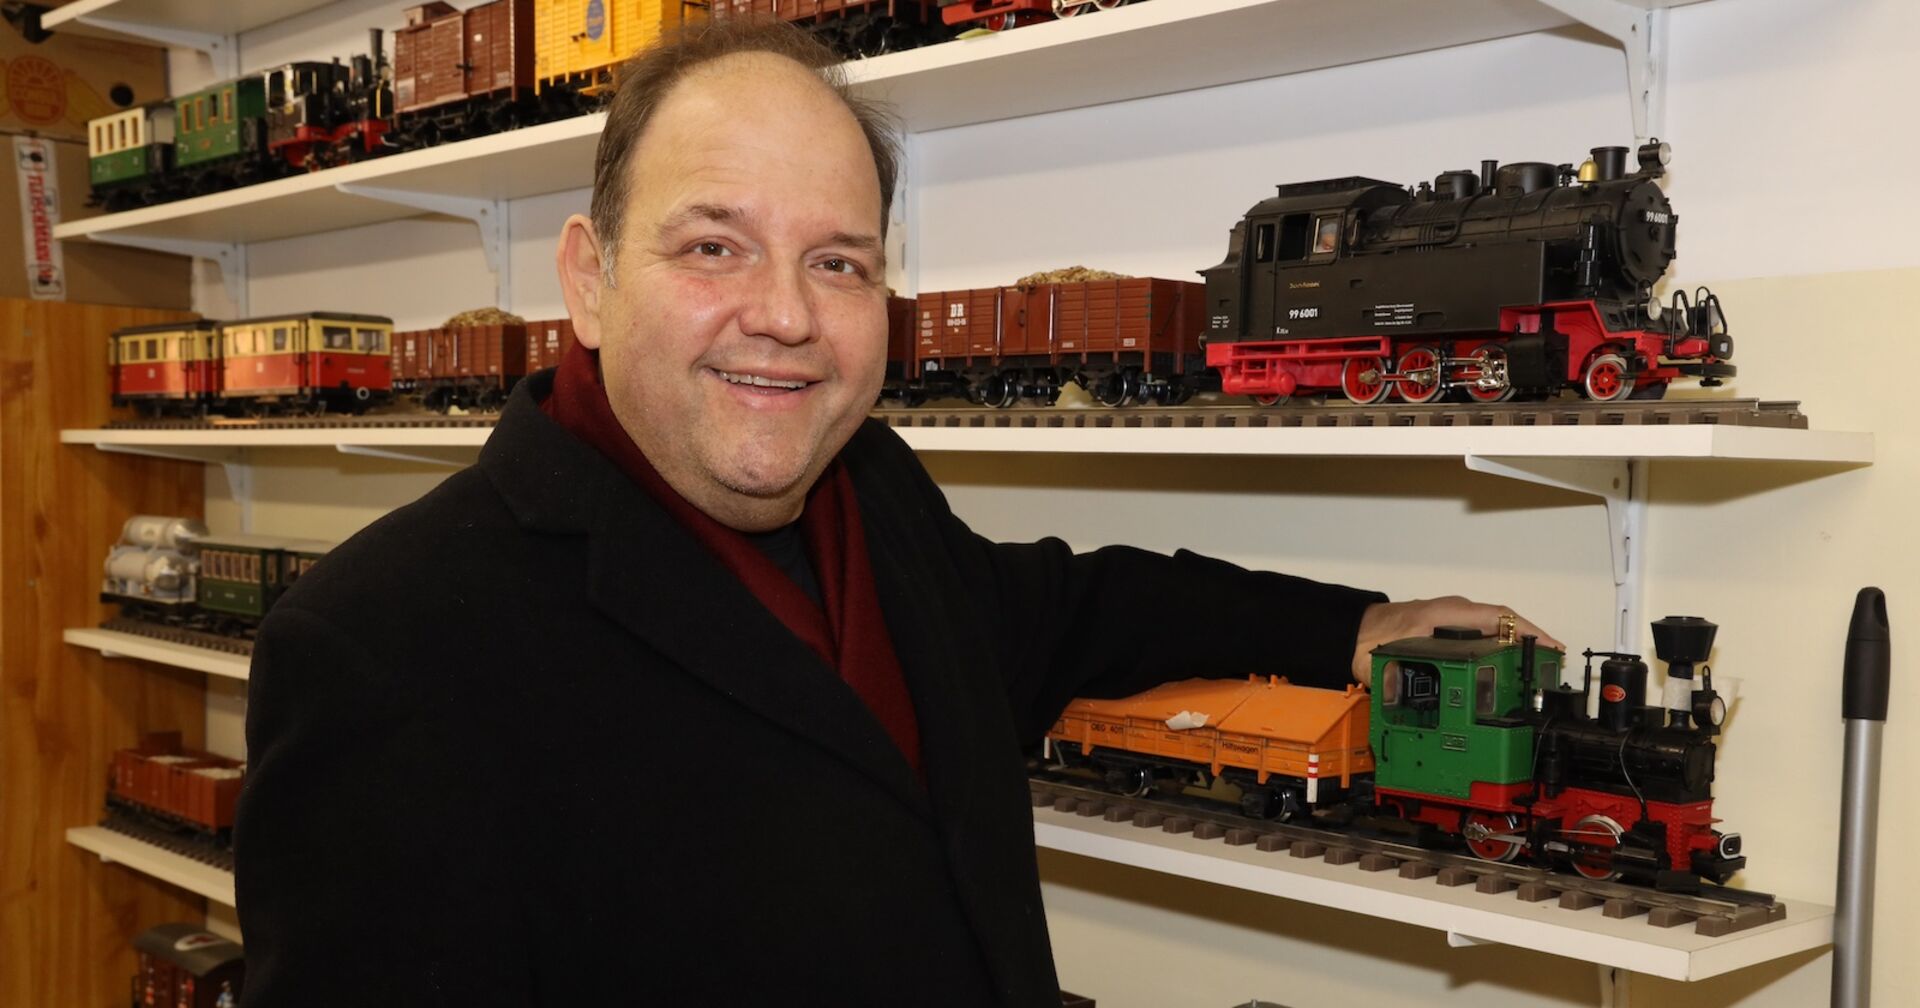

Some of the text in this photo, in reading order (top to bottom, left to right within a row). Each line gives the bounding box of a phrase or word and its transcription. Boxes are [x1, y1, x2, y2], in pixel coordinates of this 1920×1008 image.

[1646, 211, 1668, 224] 99 6001
[950, 303, 964, 318] DR
[1289, 308, 1318, 319] 99 6001
